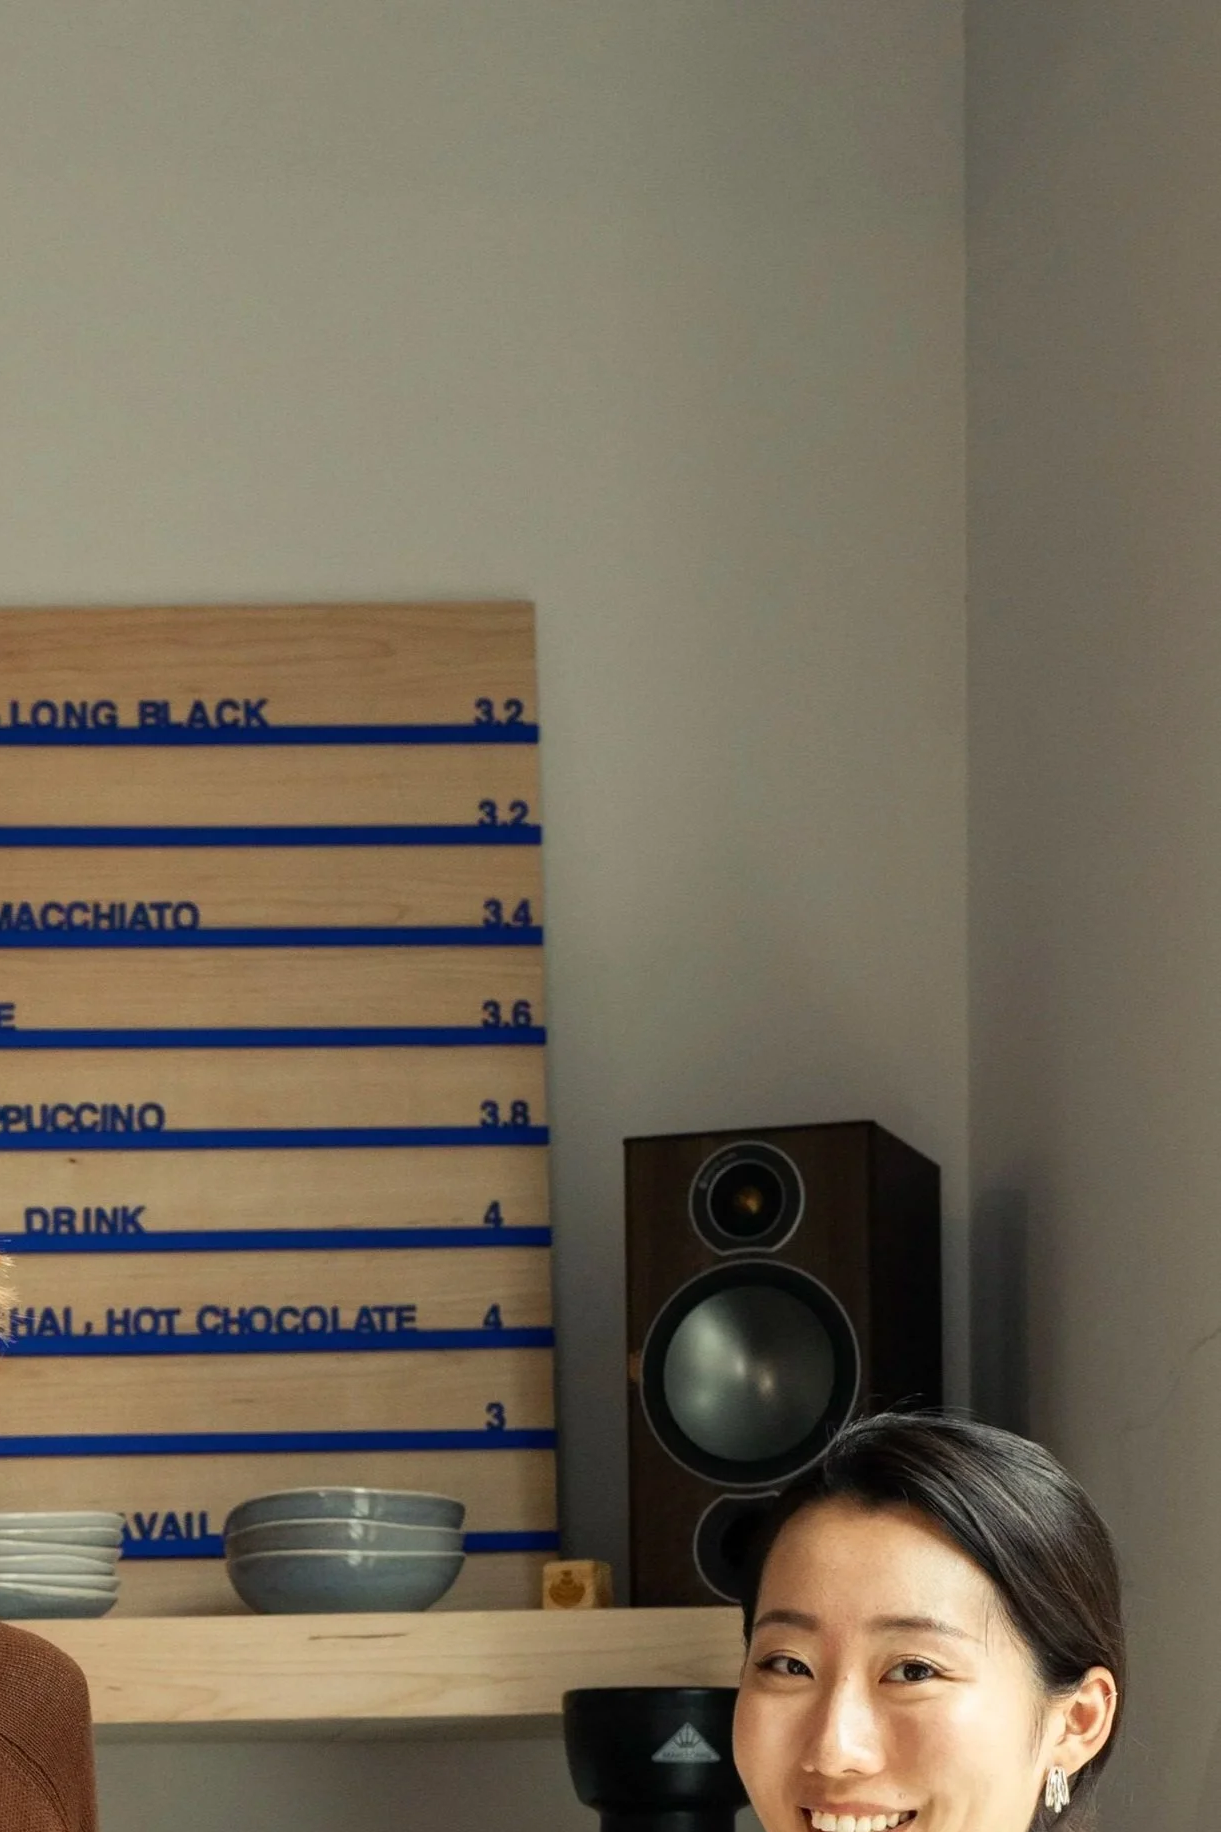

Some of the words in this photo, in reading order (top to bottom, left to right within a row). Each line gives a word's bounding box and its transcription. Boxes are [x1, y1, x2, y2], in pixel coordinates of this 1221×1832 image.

[11, 698, 119, 729] LONG
[138, 697, 269, 728] BLACK
[474, 697, 525, 726] 3.2
[479, 799, 529, 827] 3.2
[482, 898, 533, 928] 3.4
[481, 1000, 532, 1029] 3.6
[480, 1100, 531, 1128] 3.8
[25, 1205, 146, 1235] DRINK
[483, 1200, 504, 1229] 4
[106, 1307, 182, 1336] HOT
[196, 1304, 417, 1335] CHOCOLATE
[483, 1303, 503, 1329] 4
[485, 1402, 506, 1431] 3
